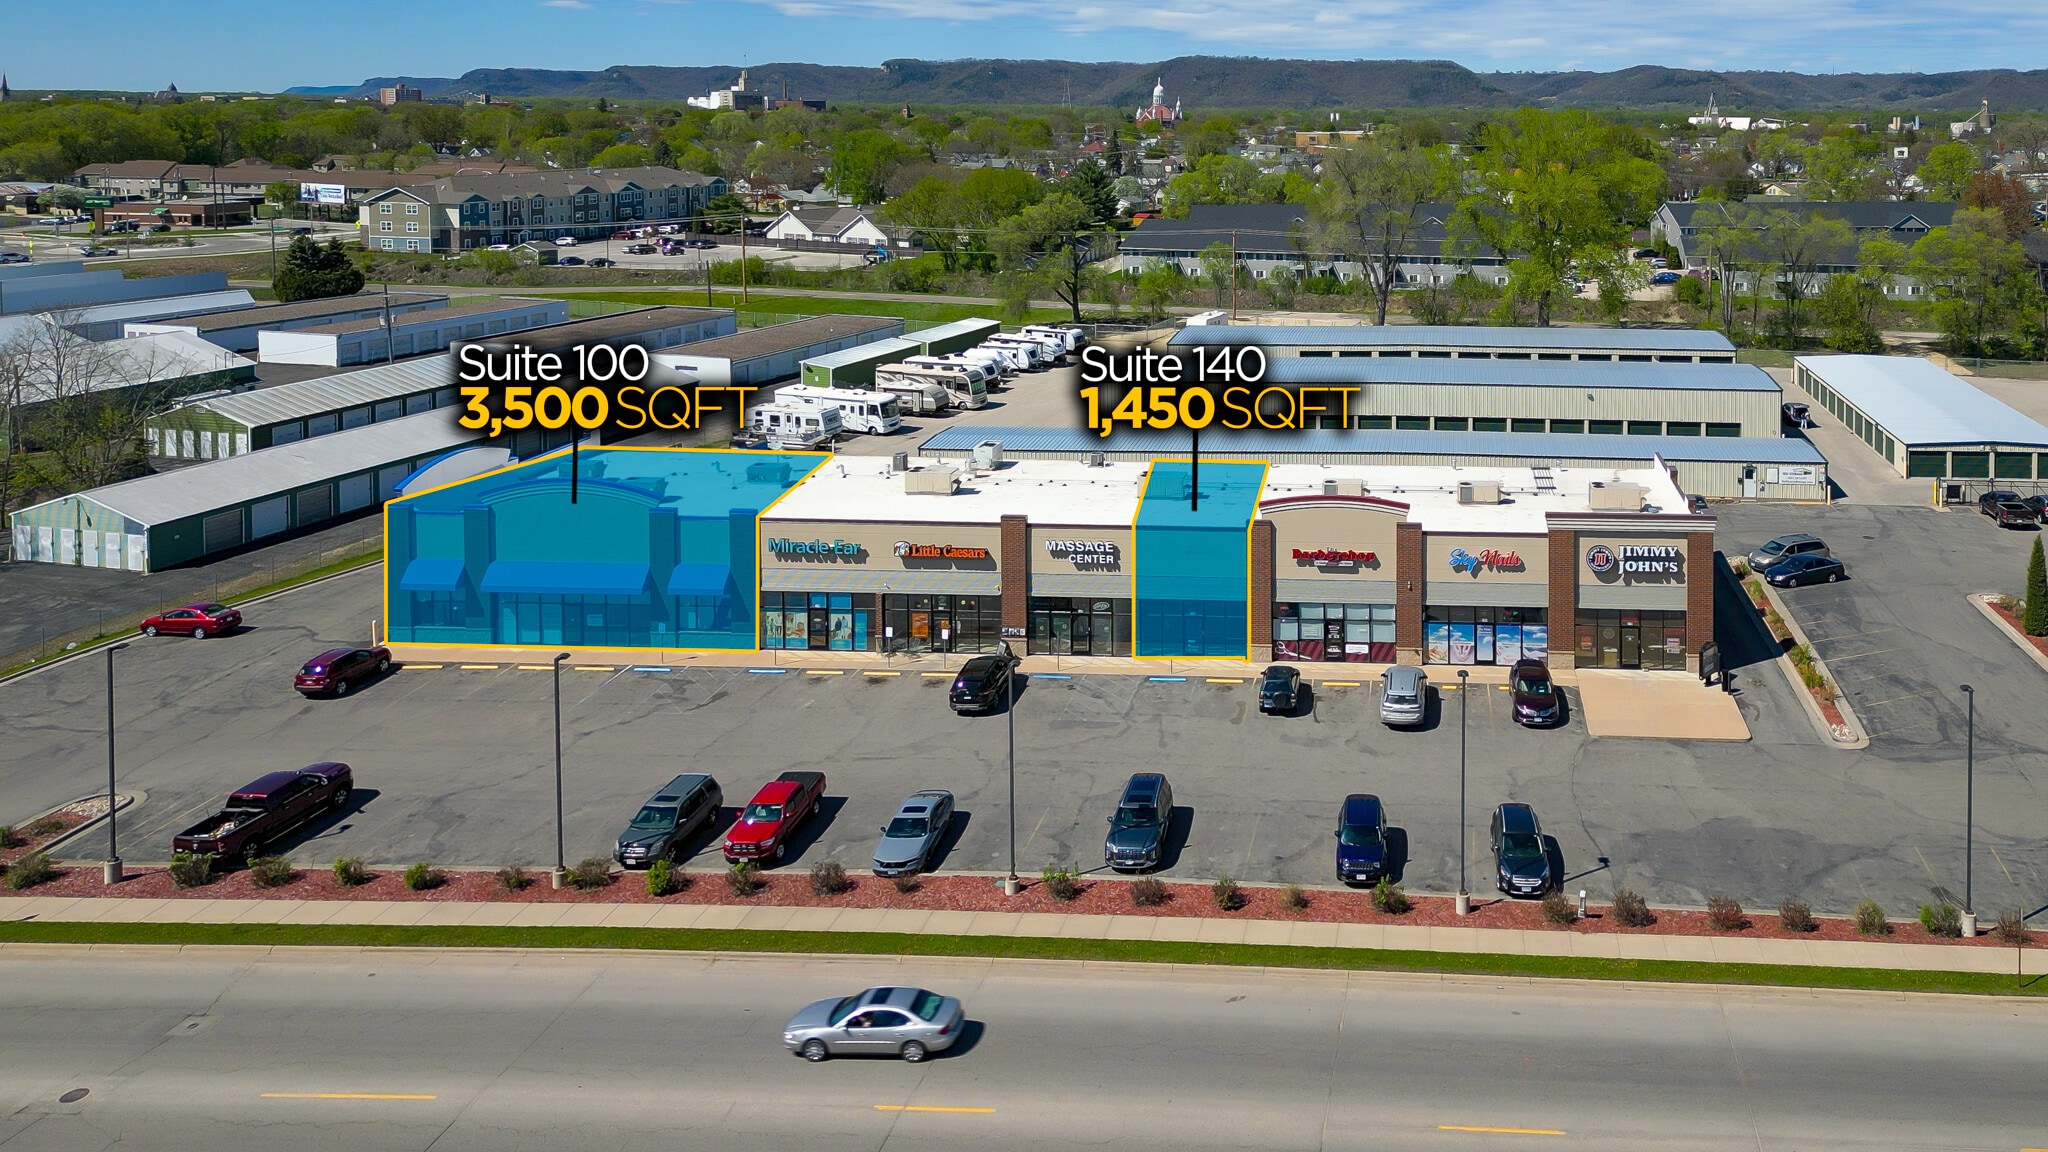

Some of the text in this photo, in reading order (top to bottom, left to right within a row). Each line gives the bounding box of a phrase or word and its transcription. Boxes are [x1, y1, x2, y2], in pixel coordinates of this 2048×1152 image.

[911, 544, 986, 558] Little Caesars
[1045, 540, 1114, 552] MASSAGE
[1618, 545, 1678, 560] JIMMY
[1068, 554, 1114, 564] CENTER
[1292, 549, 1375, 562] Barbershop
[1449, 547, 1521, 572] Sky Nails
[1618, 561, 1678, 574] JOHN'S
